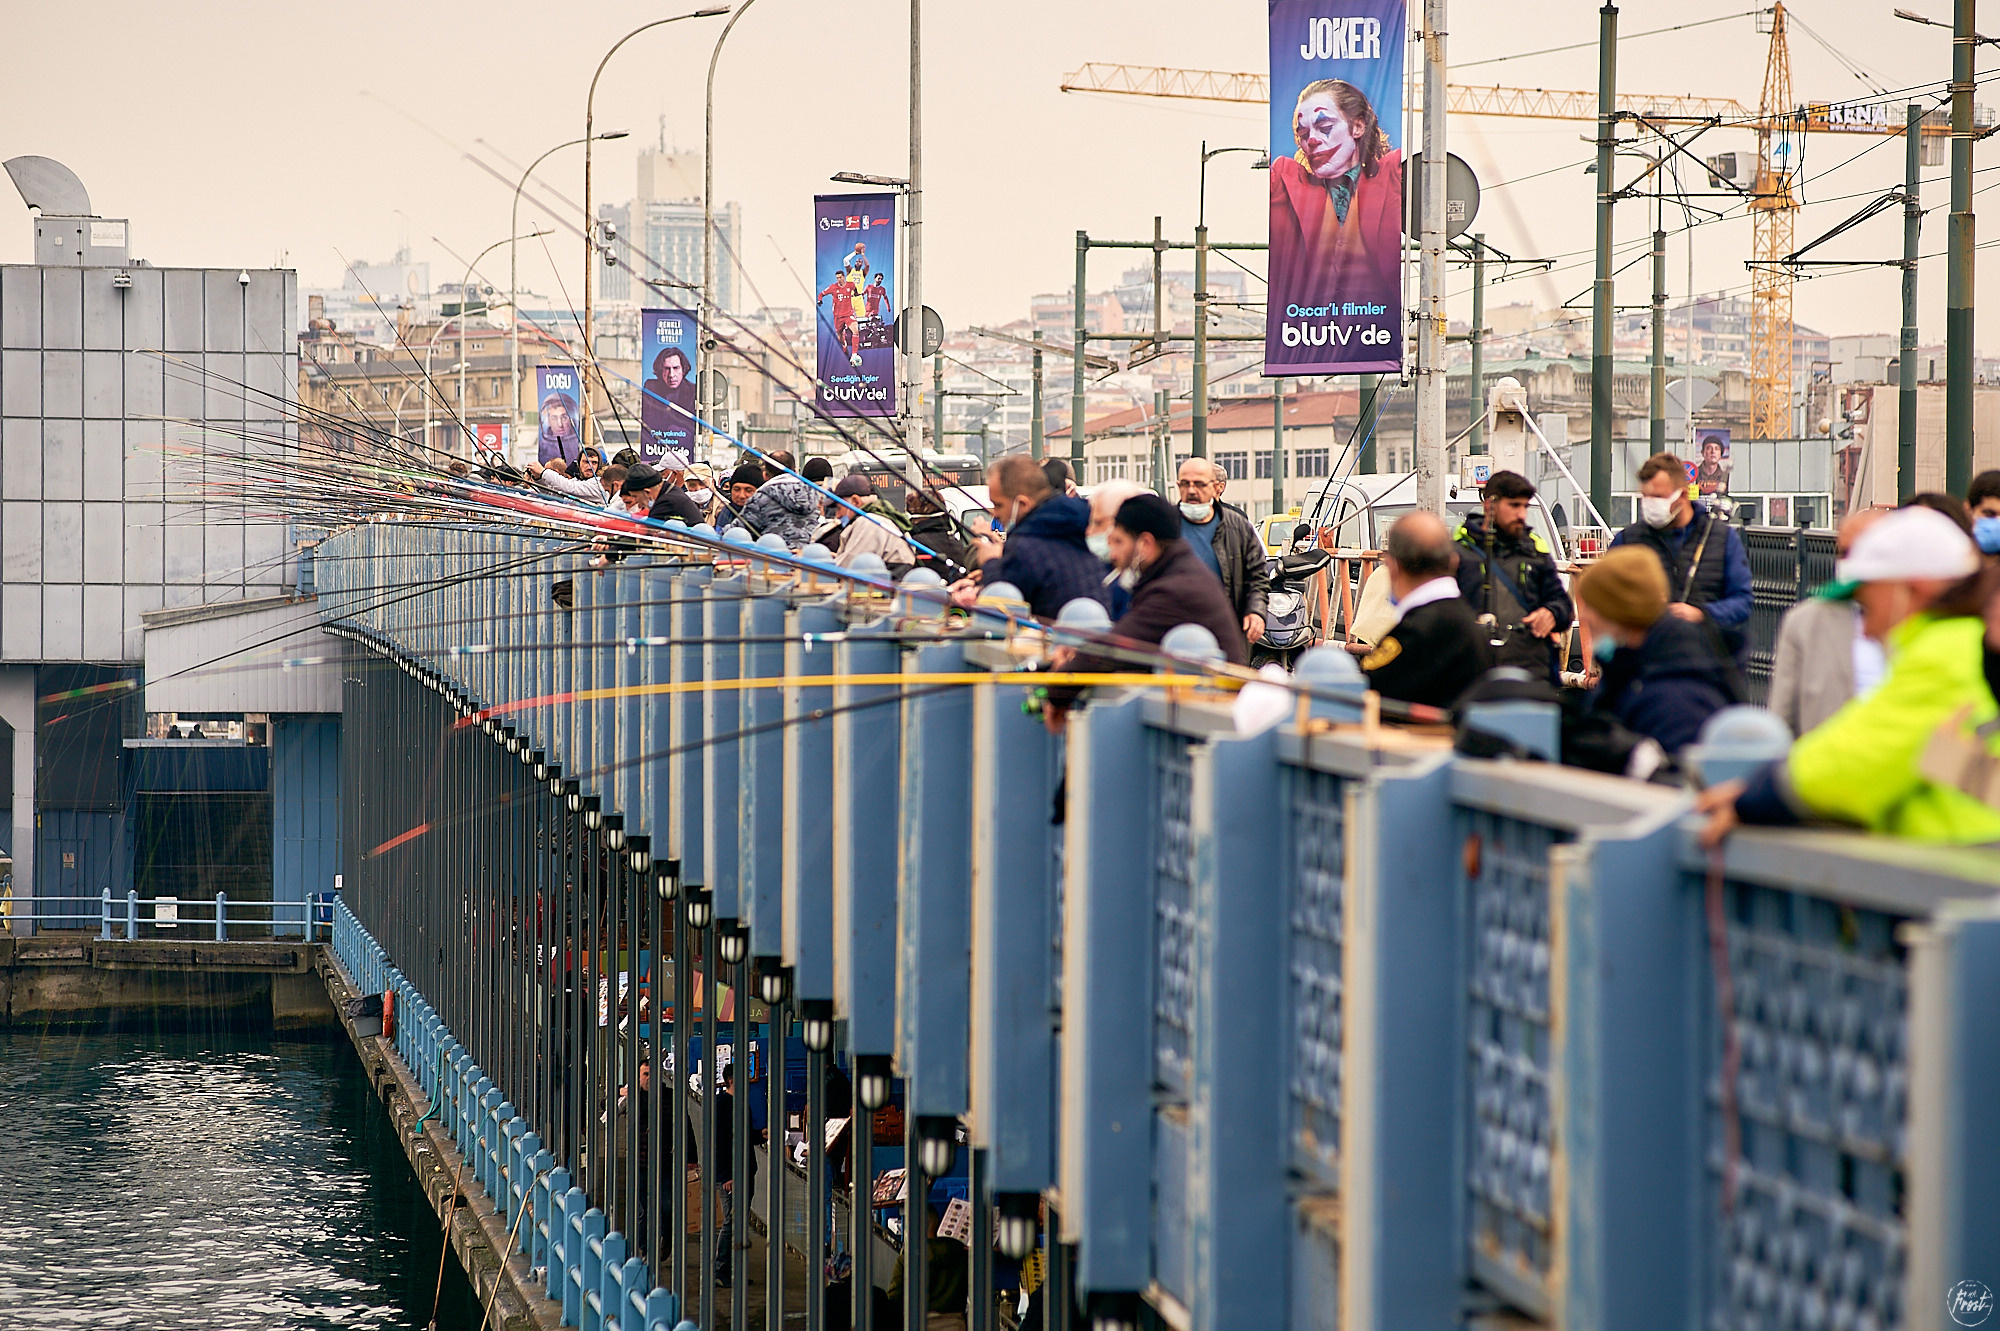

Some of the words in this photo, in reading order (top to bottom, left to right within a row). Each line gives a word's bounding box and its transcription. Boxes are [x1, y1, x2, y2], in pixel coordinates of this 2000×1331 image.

[1300, 16, 1381, 60] JOKER
[1829, 102, 1887, 126] RENA
[1341, 301, 1387, 315] filmler
[1281, 320, 1392, 347] blutv'de
[545, 372, 572, 390] DOĞU
